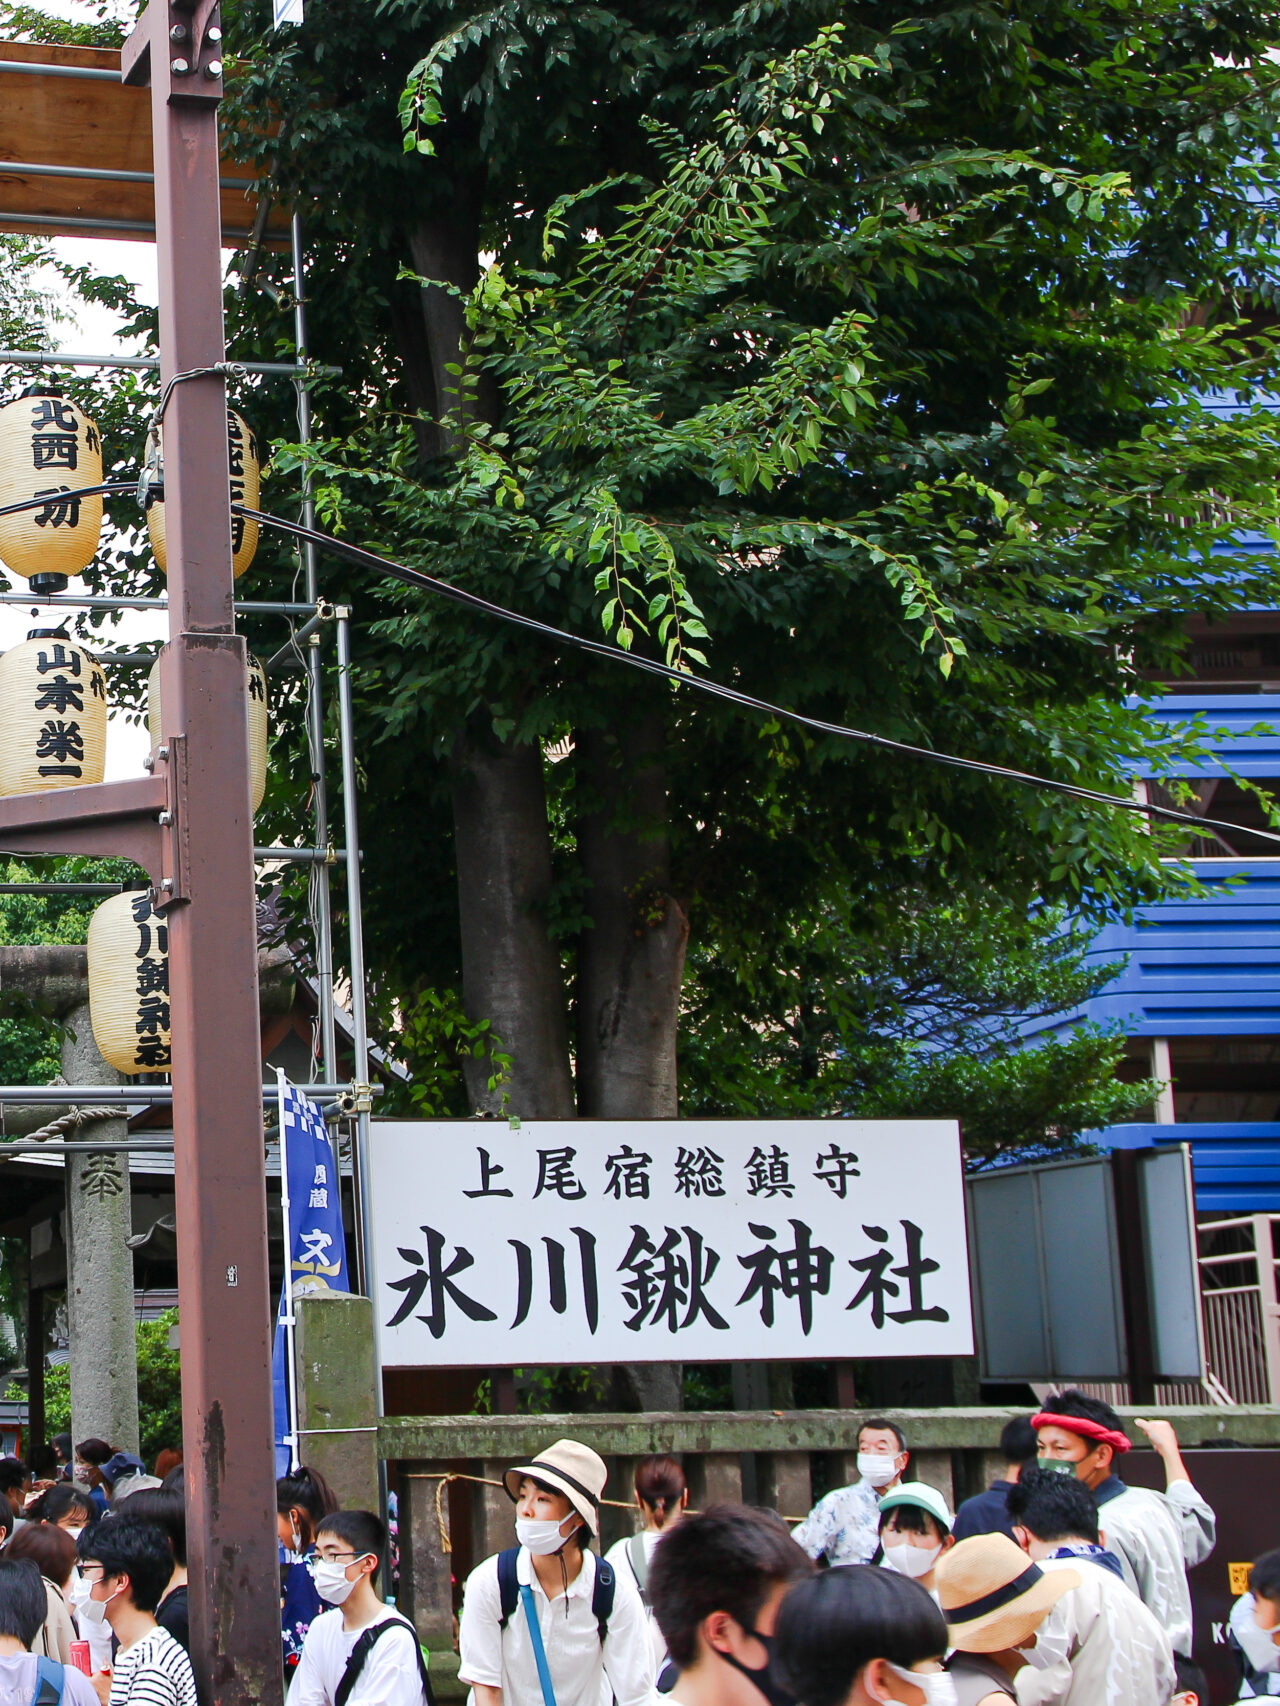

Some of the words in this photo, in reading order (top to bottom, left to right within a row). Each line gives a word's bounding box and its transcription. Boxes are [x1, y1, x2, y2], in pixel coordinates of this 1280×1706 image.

[35, 644, 84, 778] 山本栄一
[462, 1144, 862, 1200] 上尾宿総鎮守
[386, 1218, 950, 1339] 氷川鍬神社
